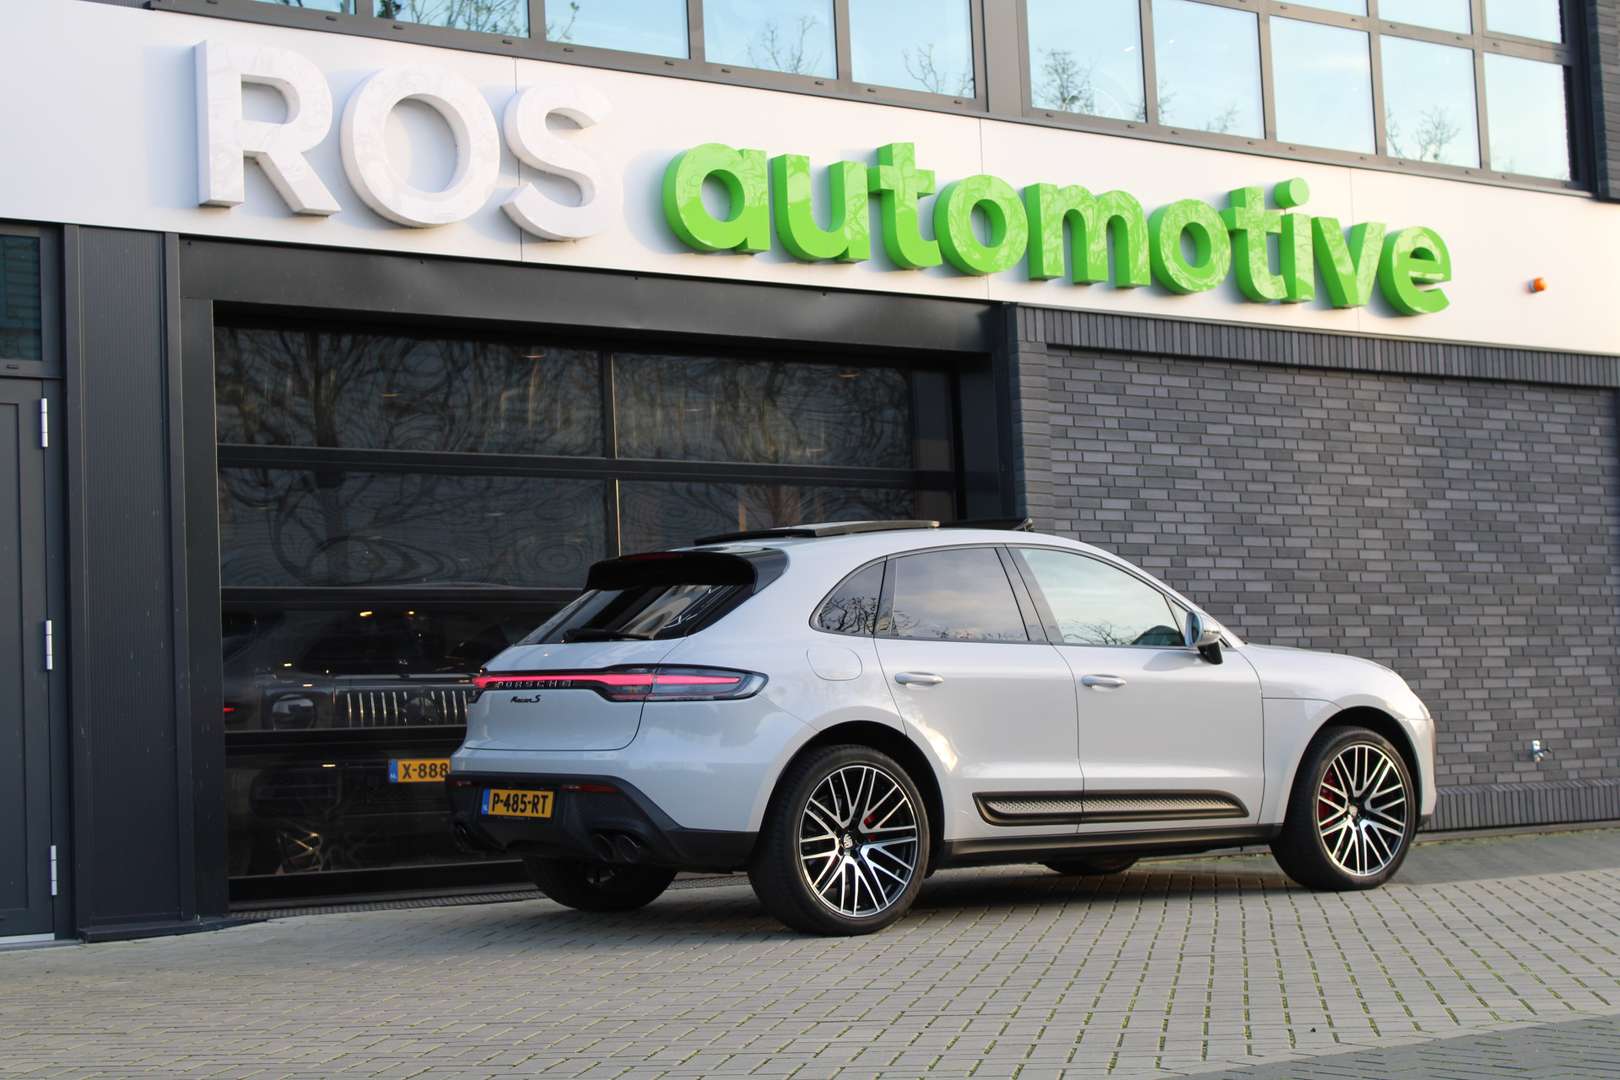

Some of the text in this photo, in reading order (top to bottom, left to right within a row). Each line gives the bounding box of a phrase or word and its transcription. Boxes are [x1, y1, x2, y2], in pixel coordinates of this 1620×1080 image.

[194, 39, 1452, 314] ROS automotive
[492, 793, 549, 814] P-485-RT
